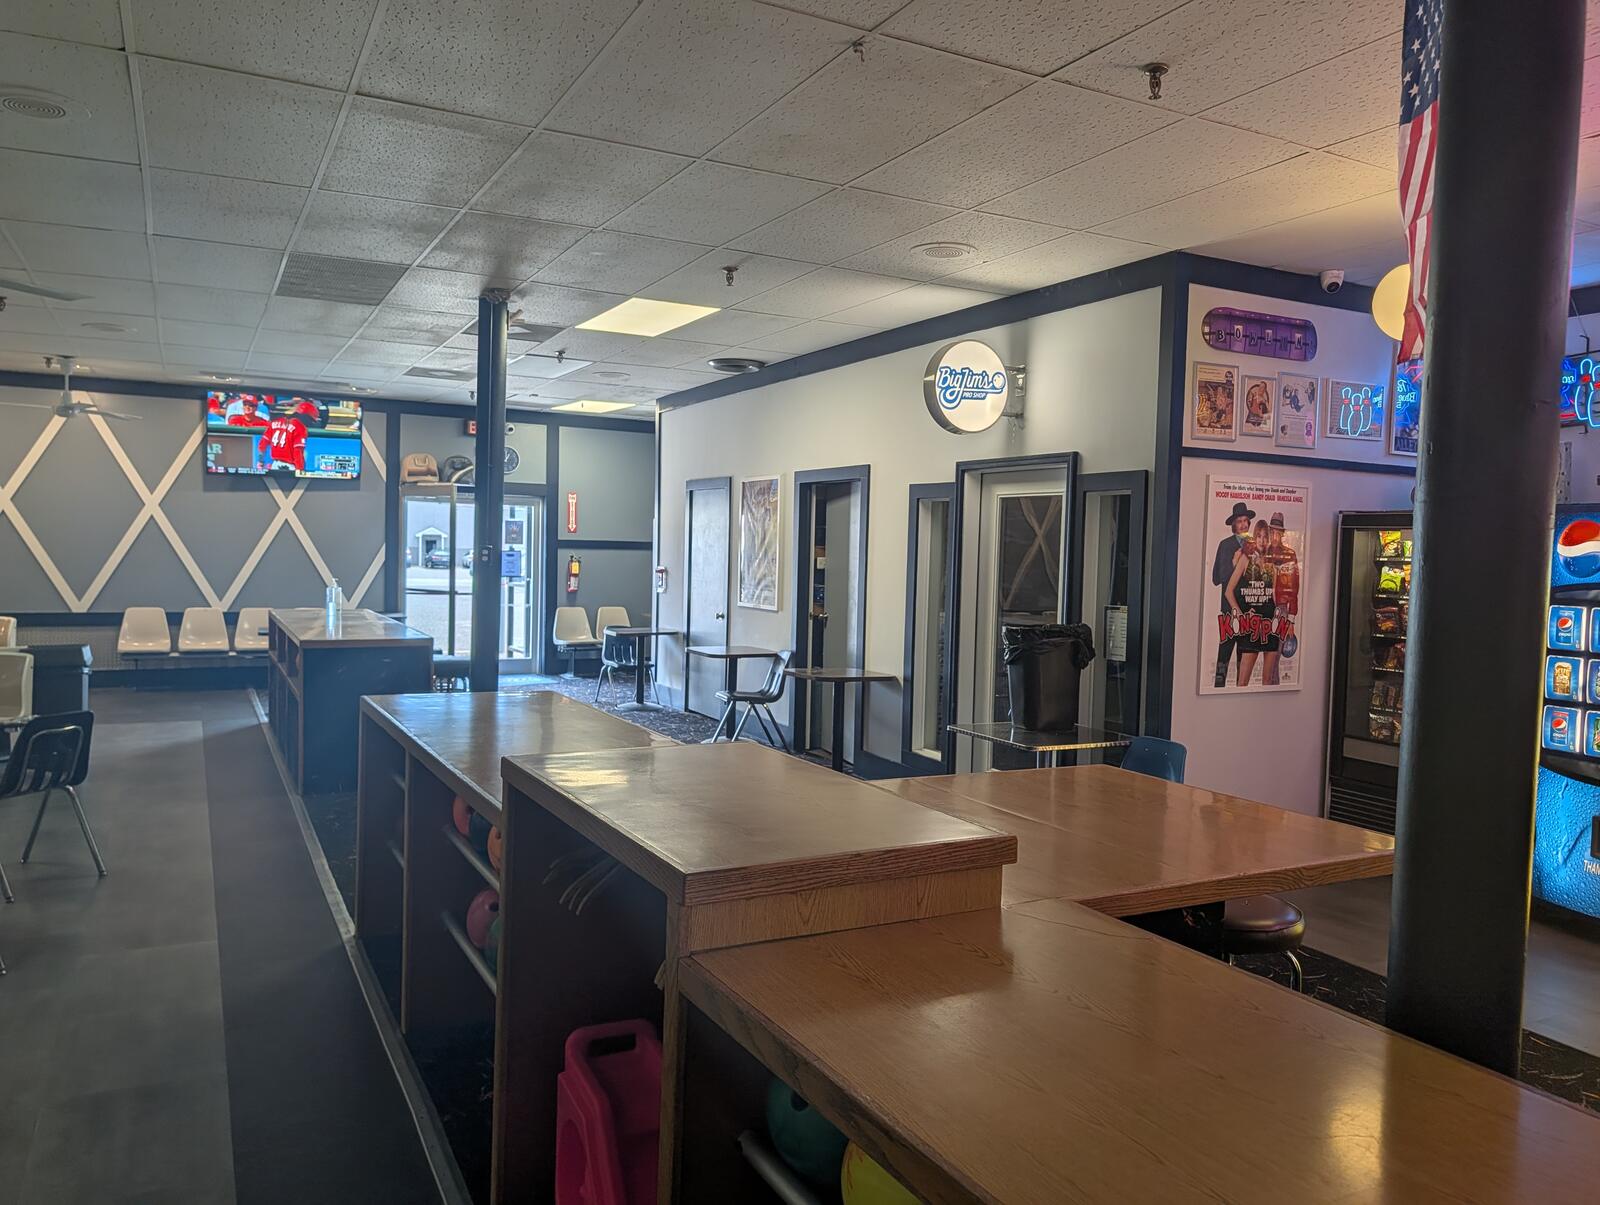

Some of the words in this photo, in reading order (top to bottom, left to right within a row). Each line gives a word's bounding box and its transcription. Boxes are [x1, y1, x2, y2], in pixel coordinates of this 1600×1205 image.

[938, 366, 962, 401] Big
[958, 367, 992, 396] Jim's
[271, 430, 287, 447] 44
